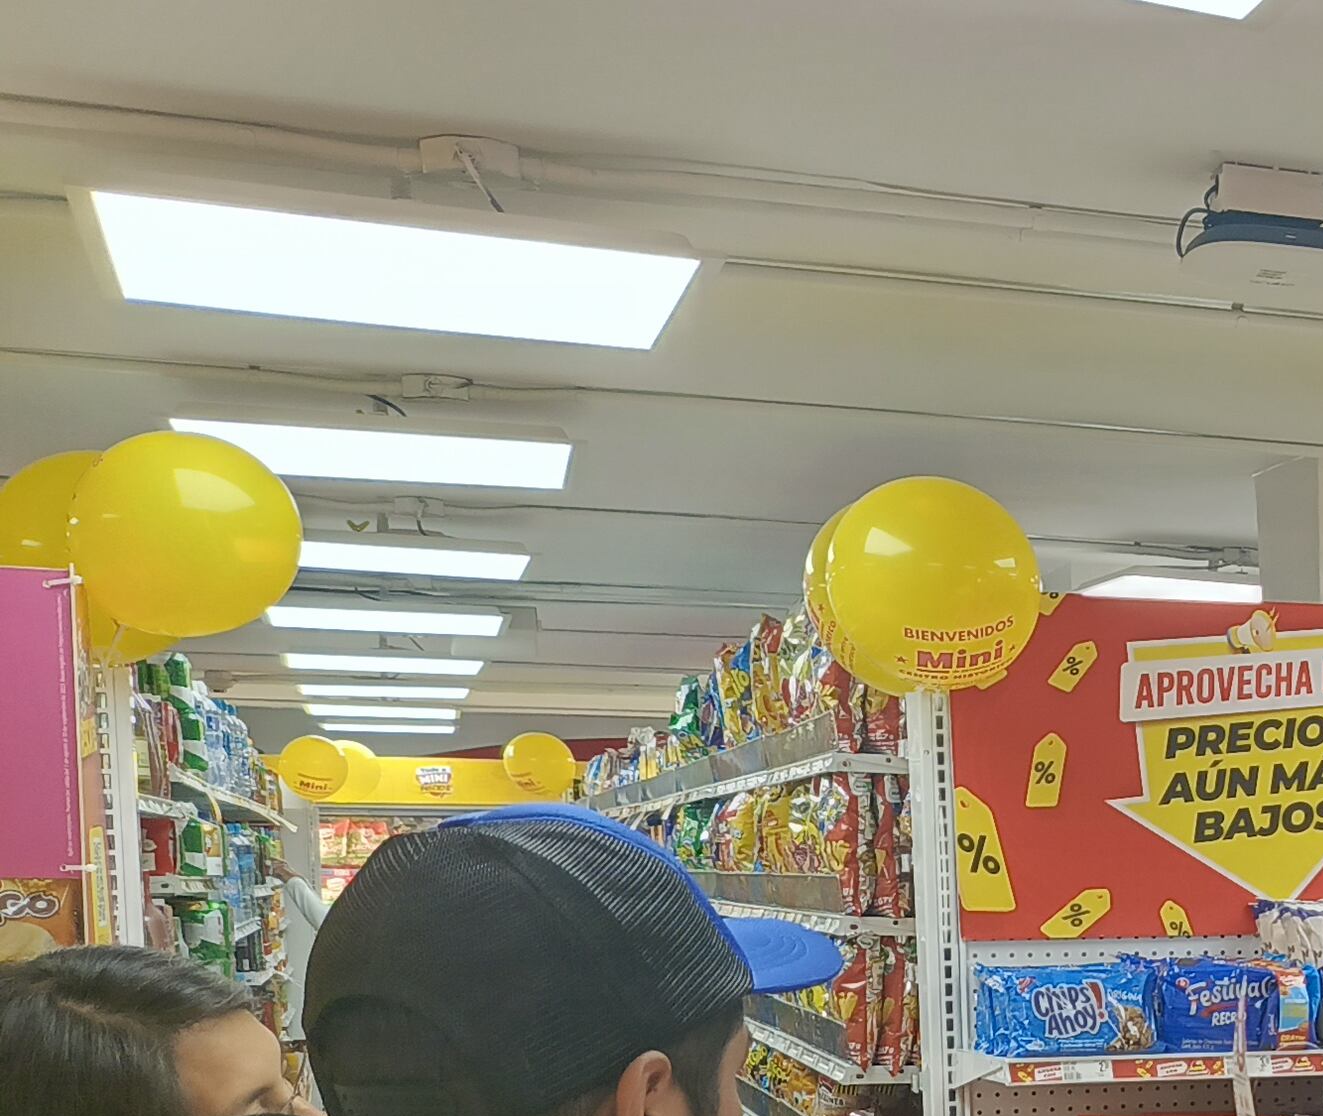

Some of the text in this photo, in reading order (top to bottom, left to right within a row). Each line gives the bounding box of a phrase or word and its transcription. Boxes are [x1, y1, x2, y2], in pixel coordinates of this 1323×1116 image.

[904, 615, 1015, 642] BIENVENIDOS
[916, 639, 1004, 670] Mini
[1134, 660, 1314, 709] APROVECHA
[1158, 759, 1260, 806] AÚN
